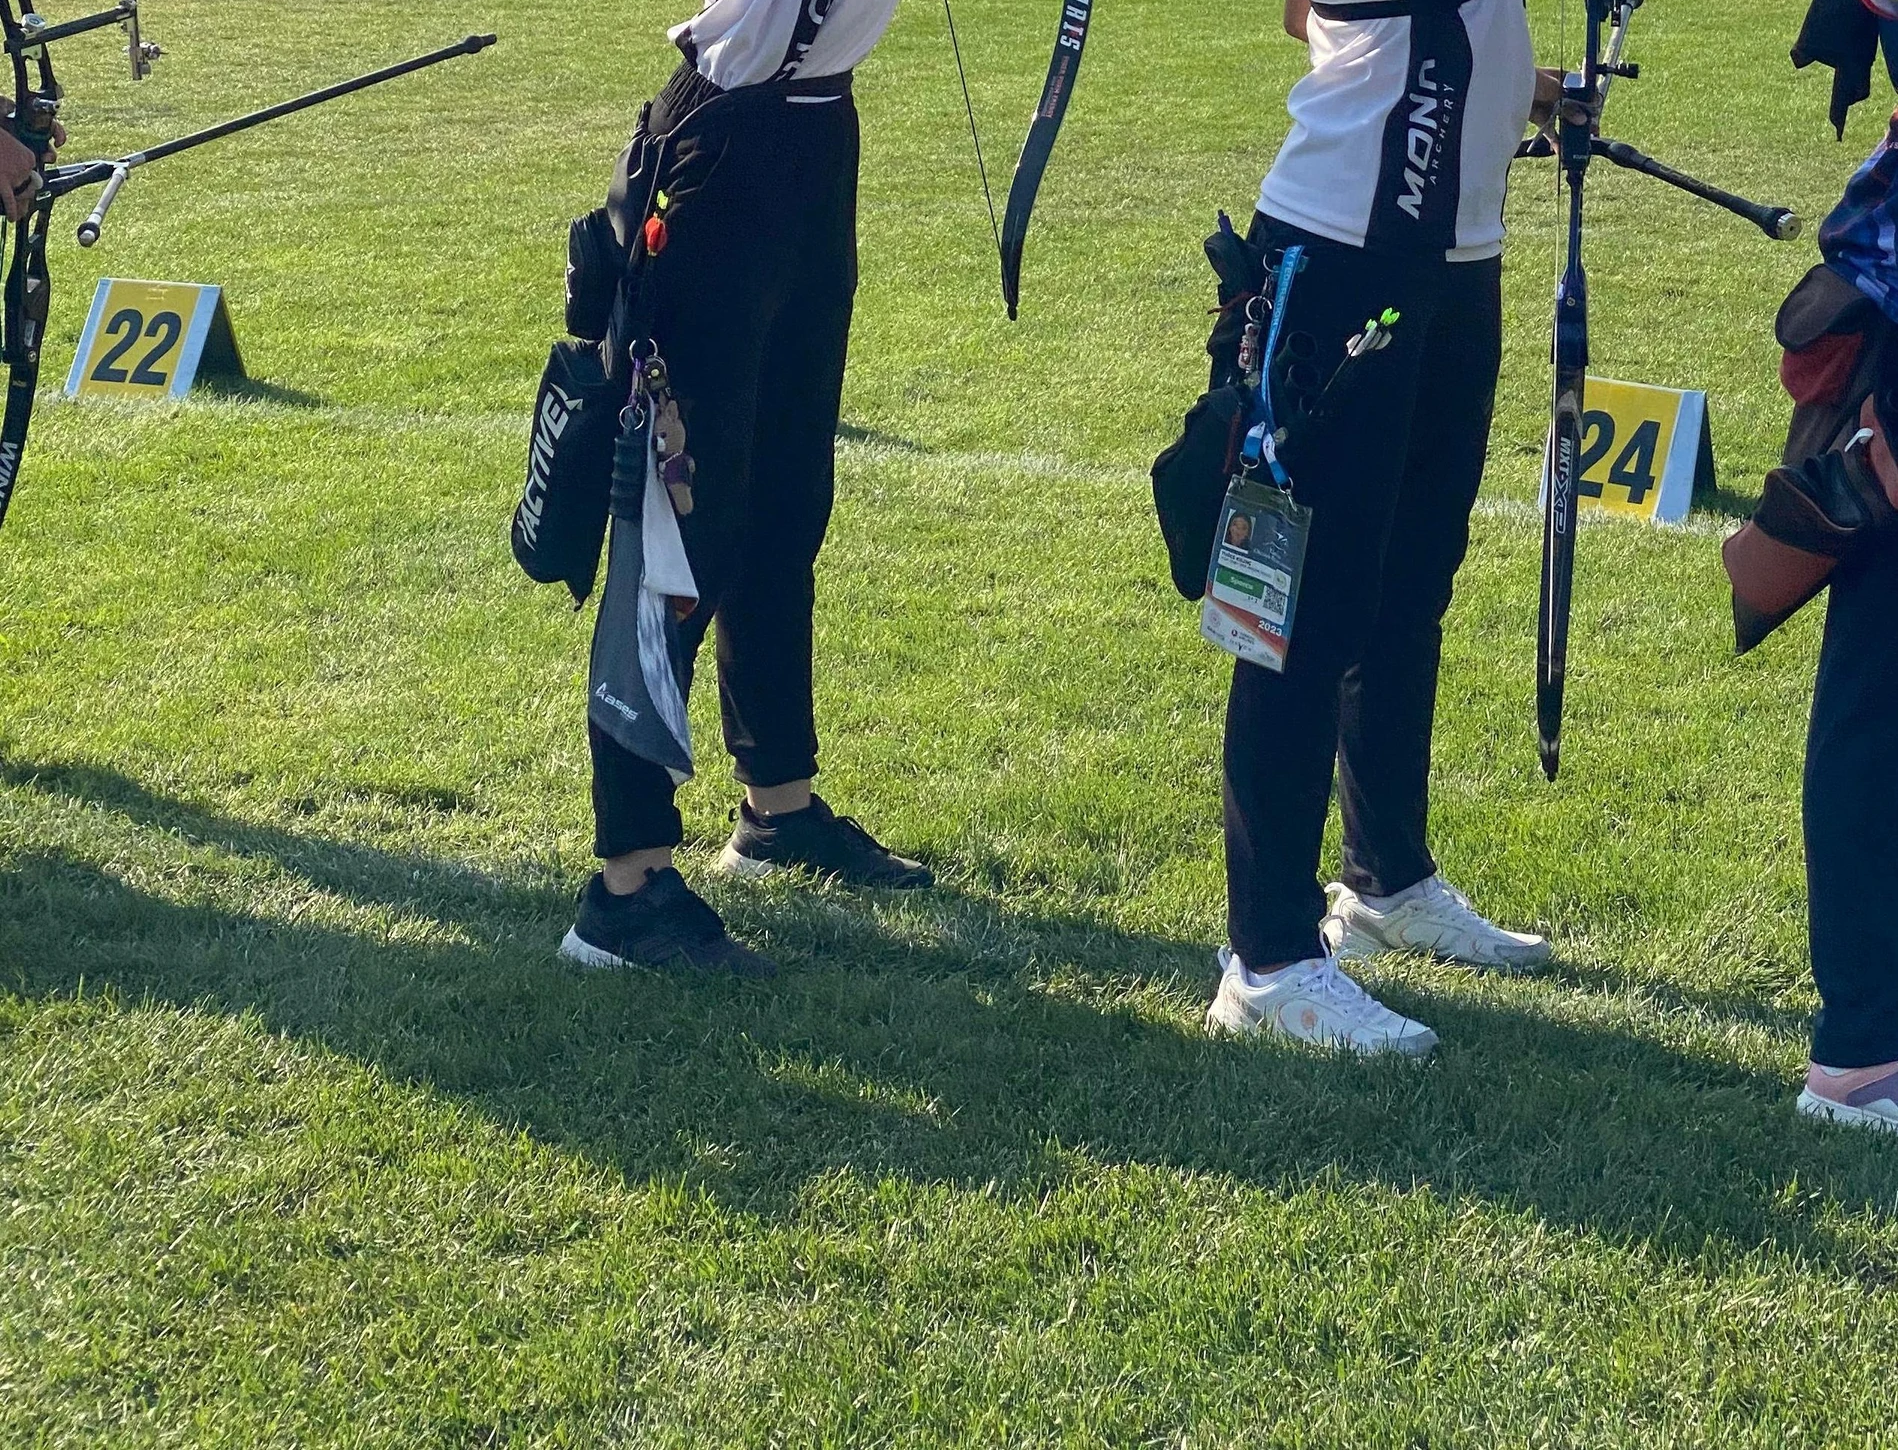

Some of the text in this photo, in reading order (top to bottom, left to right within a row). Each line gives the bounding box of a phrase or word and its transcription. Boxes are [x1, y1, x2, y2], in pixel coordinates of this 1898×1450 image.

[1429, 83, 1455, 186] ARCHERY
[1272, 261, 1294, 326] FEDERATION
[90, 308, 182, 386] 22
[1578, 410, 1661, 505] 24
[1258, 619, 1283, 637] 2023
